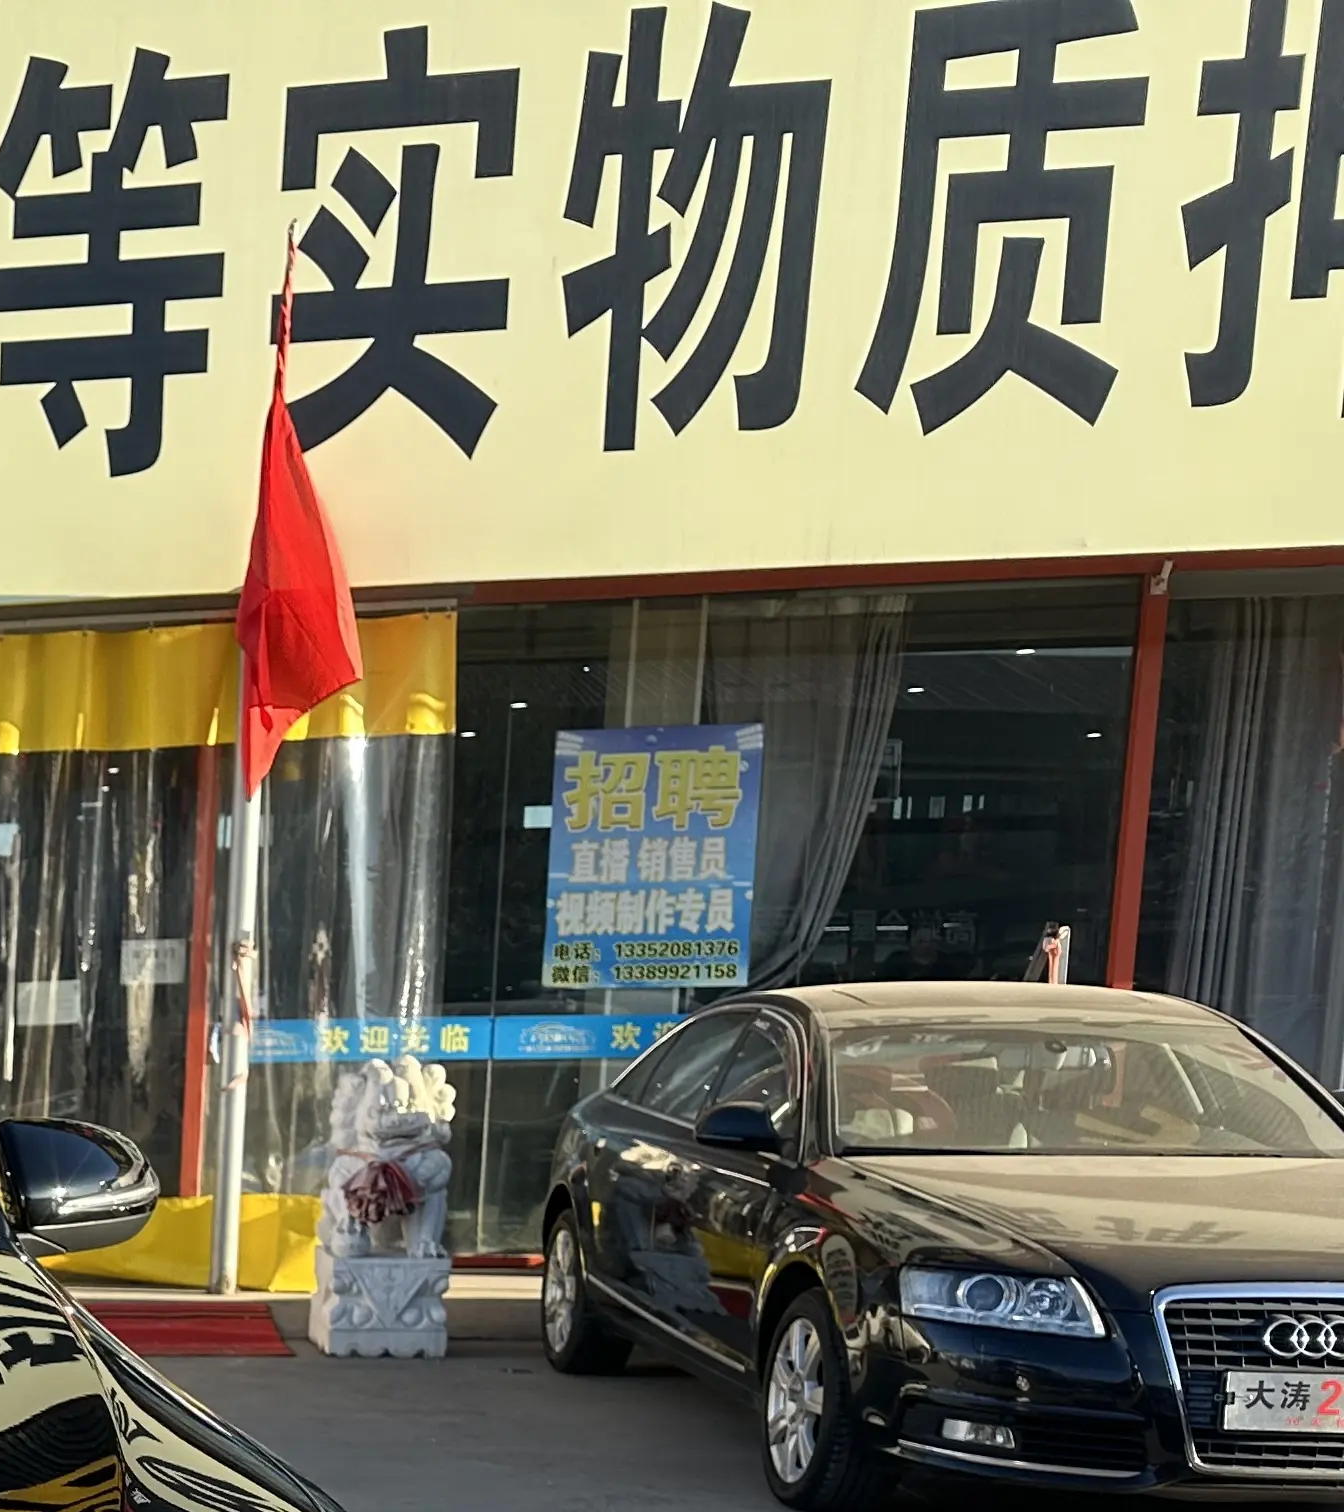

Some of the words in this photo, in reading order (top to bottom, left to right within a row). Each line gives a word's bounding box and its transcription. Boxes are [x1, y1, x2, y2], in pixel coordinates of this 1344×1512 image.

[564, 745, 742, 832] 招聘
[568, 837, 630, 883] 直播
[637, 836, 728, 882] 销售员
[555, 887, 735, 937] 视频制作专员
[613, 940, 740, 960] 13352081376
[613, 962, 738, 982] 13389921158
[320, 1024, 470, 1054] 欢迎光临
